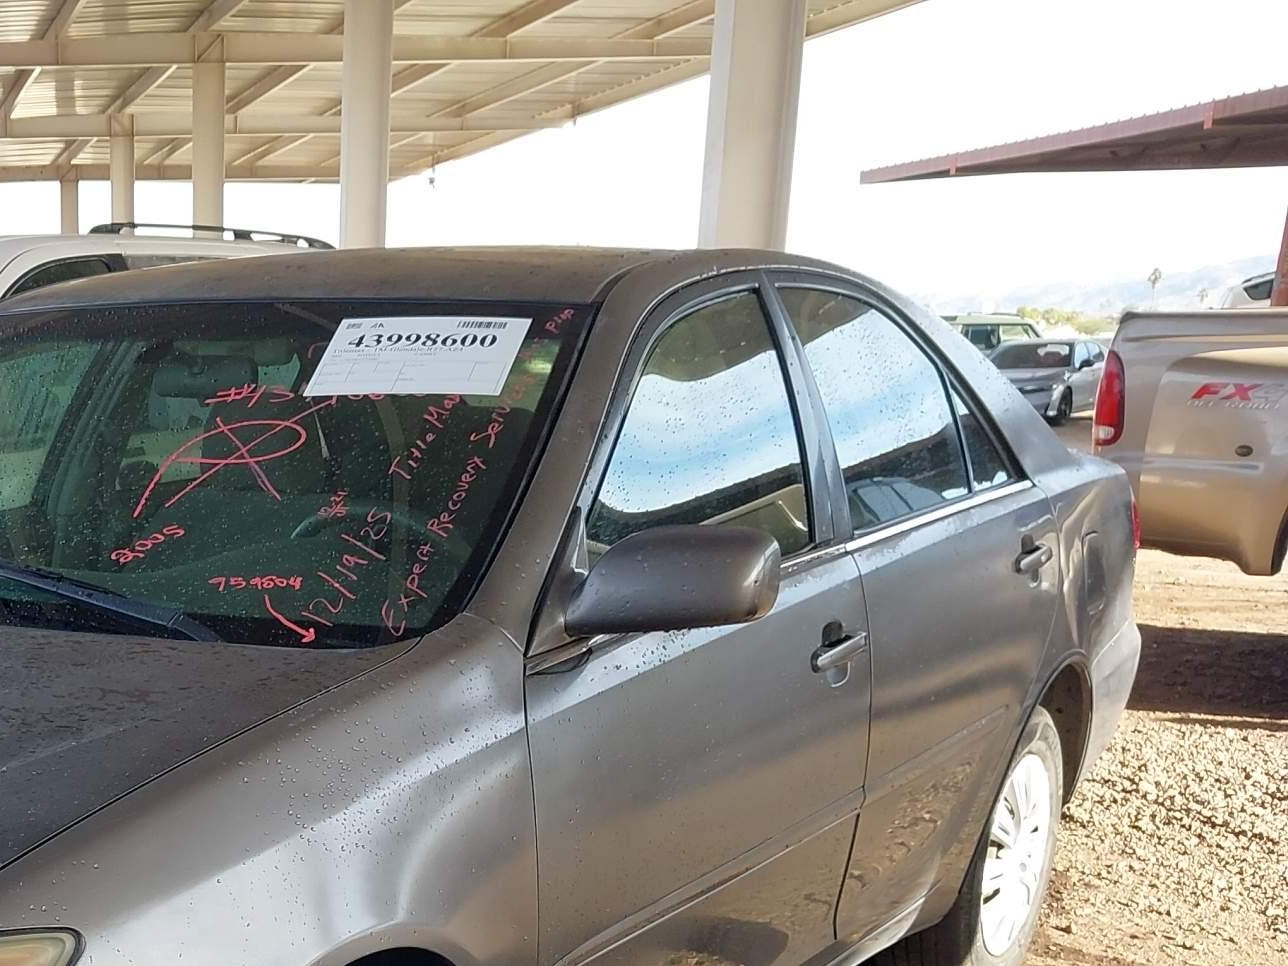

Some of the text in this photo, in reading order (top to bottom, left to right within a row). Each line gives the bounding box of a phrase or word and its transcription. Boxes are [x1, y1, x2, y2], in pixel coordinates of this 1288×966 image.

[347, 332, 499, 348] 43998600
[111, 523, 186, 566] 2005
[300, 506, 392, 627] 12/19/25
